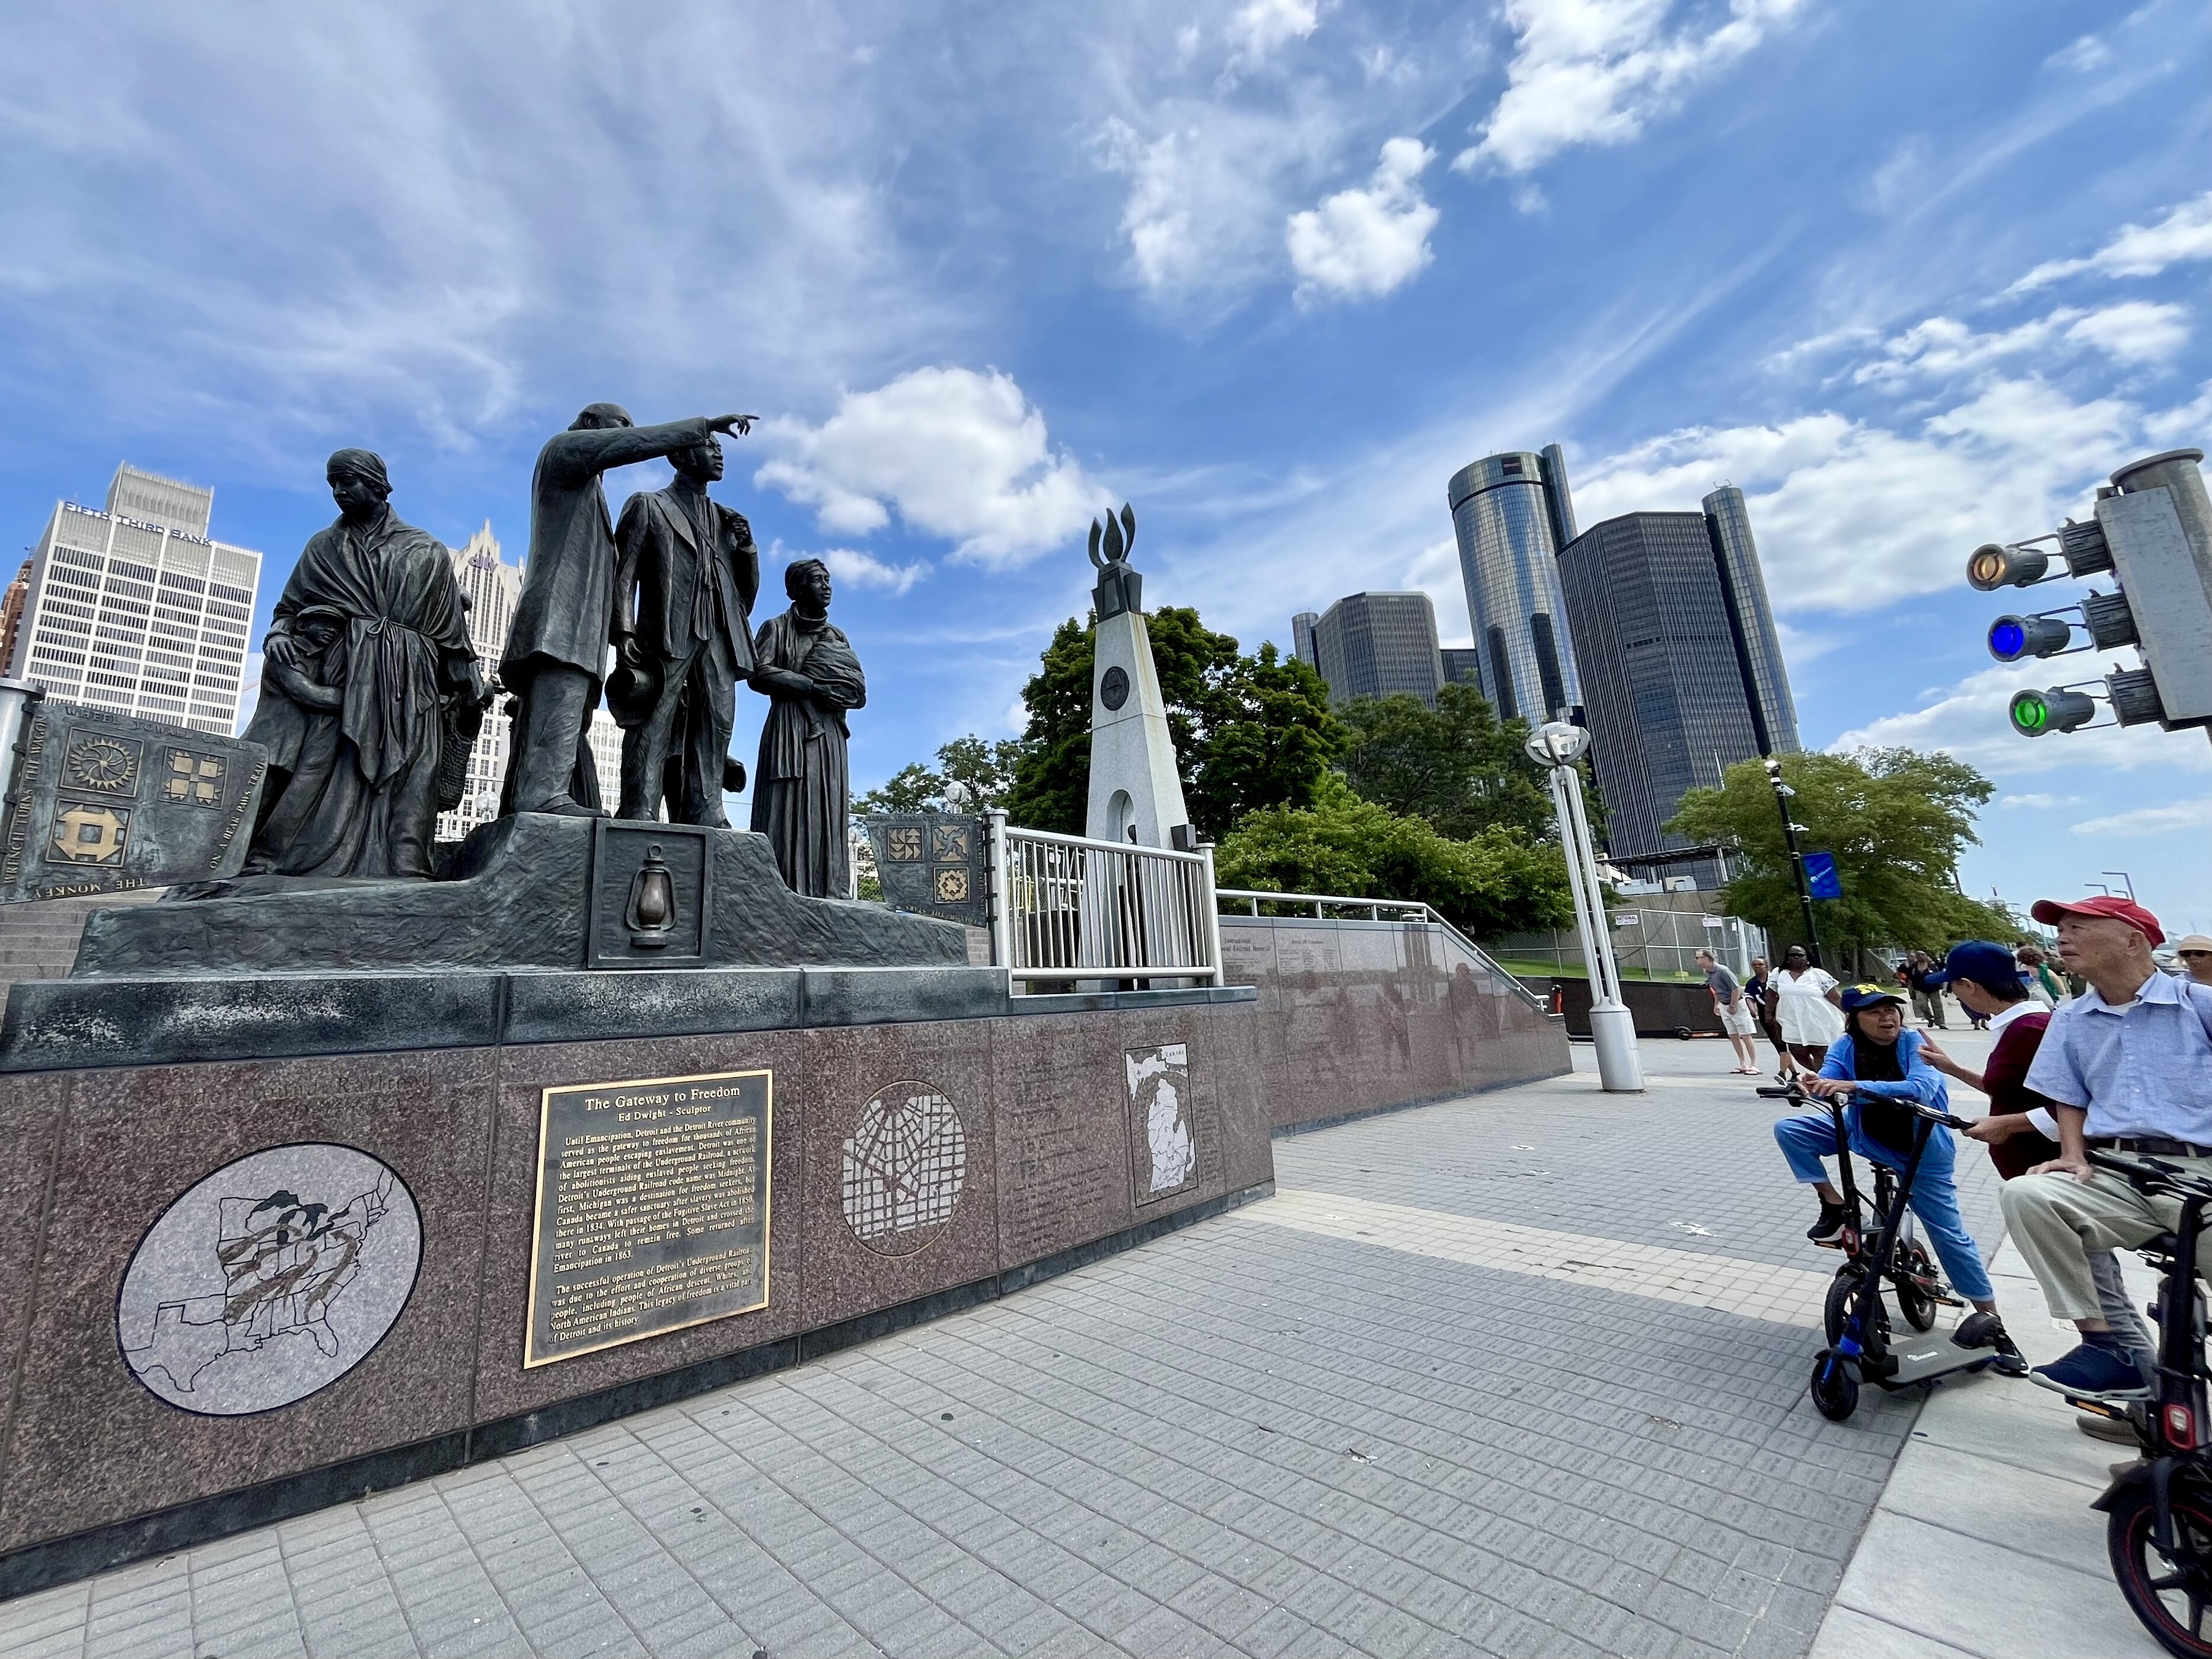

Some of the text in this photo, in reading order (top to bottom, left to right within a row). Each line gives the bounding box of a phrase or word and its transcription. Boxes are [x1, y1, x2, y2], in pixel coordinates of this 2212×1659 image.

[170, 529, 213, 546] BANK
[65, 706, 120, 725] WHEEL
[132, 721, 193, 740] TOWARD
[4, 715, 47, 884] WRENCH TURNS THE WAGON
[209, 761, 266, 870] ON A BEAR PAWS TRAIL
[33, 878, 146, 899] THE MONKEY
[905, 905, 926, 913] STARS
[949, 915, 977, 924] FOLLOW
[337, 1072, 432, 1095] Railroad
[585, 1086, 741, 1111] The Gateway to Freedom
[617, 1113, 630, 1122] Ed
[634, 1109, 666, 1120] Dwight
[676, 1106, 711, 1115] Sculptor
[561, 1147, 584, 1157] served
[598, 1144, 609, 1153] the
[613, 1142, 639, 1153] gateway
[652, 1136, 678, 1145] freedom
[693, 1130, 723, 1141] thousands
[566, 1136, 584, 1146] Until
[635, 1128, 658, 1138] Detroit
[660, 1126, 671, 1134] and
[685, 1122, 706, 1131] Detroit
[560, 1158, 594, 1168] American
[598, 1154, 620, 1166] people
[623, 1149, 652, 1160] escaping
[699, 1140, 719, 1150] Detroit
[560, 1171, 570, 1180] the
[573, 1168, 597, 1179] largest
[600, 1163, 631, 1174] terminals
[633, 1161, 641, 1170] of
[643, 1160, 653, 1168] the
[655, 1154, 696, 1166] Underground
[558, 1191, 589, 1203] Detroit's
[592, 1183, 636, 1198] Underground
[639, 1179, 667, 1190] Railroad
[669, 1177, 684, 1186] code
[559, 1161, 725, 1192] of abolitionists aiding enslaved people seeking
[579, 1200, 611, 1211] Michigan
[639, 1189, 675, 1201] destination
[679, 1186, 689, 1195] for
[691, 1183, 716, 1192] freedom
[556, 1214, 585, 1226] Canada
[586, 1211, 611, 1221] became
[621, 1205, 638, 1215] safer
[640, 1201, 670, 1212] sanctuary
[673, 1197, 689, 1206] after
[556, 1229, 574, 1237] there
[576, 1225, 584, 1234] in
[607, 1218, 623, 1228] With
[626, 1215, 651, 1227] passage
[653, 1211, 661, 1220] of
[662, 1211, 672, 1219] the
[674, 1206, 699, 1217] Fugitive
[701, 1203, 717, 1212] Slave
[719, 1201, 729, 1209] Act
[614, 1229, 626, 1238] left
[630, 1225, 646, 1236] their
[649, 1222, 669, 1232] homes
[683, 1215, 704, 1225] Detroit
[707, 1212, 718, 1221] and
[592, 1242, 619, 1254] Canada
[687, 1227, 704, 1236] Some
[709, 1219, 735, 1231] returned
[554, 1257, 603, 1274] Emancipation
[605, 1254, 612, 1263] in
[556, 1251, 726, 1294] The successful operation of Detroit's Underground
[569, 1294, 582, 1304] due
[597, 1288, 607, 1298] the
[611, 1284, 630, 1294] effort
[633, 1279, 646, 1289] and
[649, 1272, 687, 1286] cooperation
[690, 1268, 697, 1276] of
[699, 1265, 721, 1274] diverse
[583, 1284, 683, 1312] including people of African
[573, 1313, 607, 1326] American
[639, 1300, 654, 1310] This
[655, 1296, 676, 1309] legacy
[678, 1291, 686, 1301] of
[687, 1288, 712, 1299] freedom
[560, 1322, 614, 1340] Detroit and its
